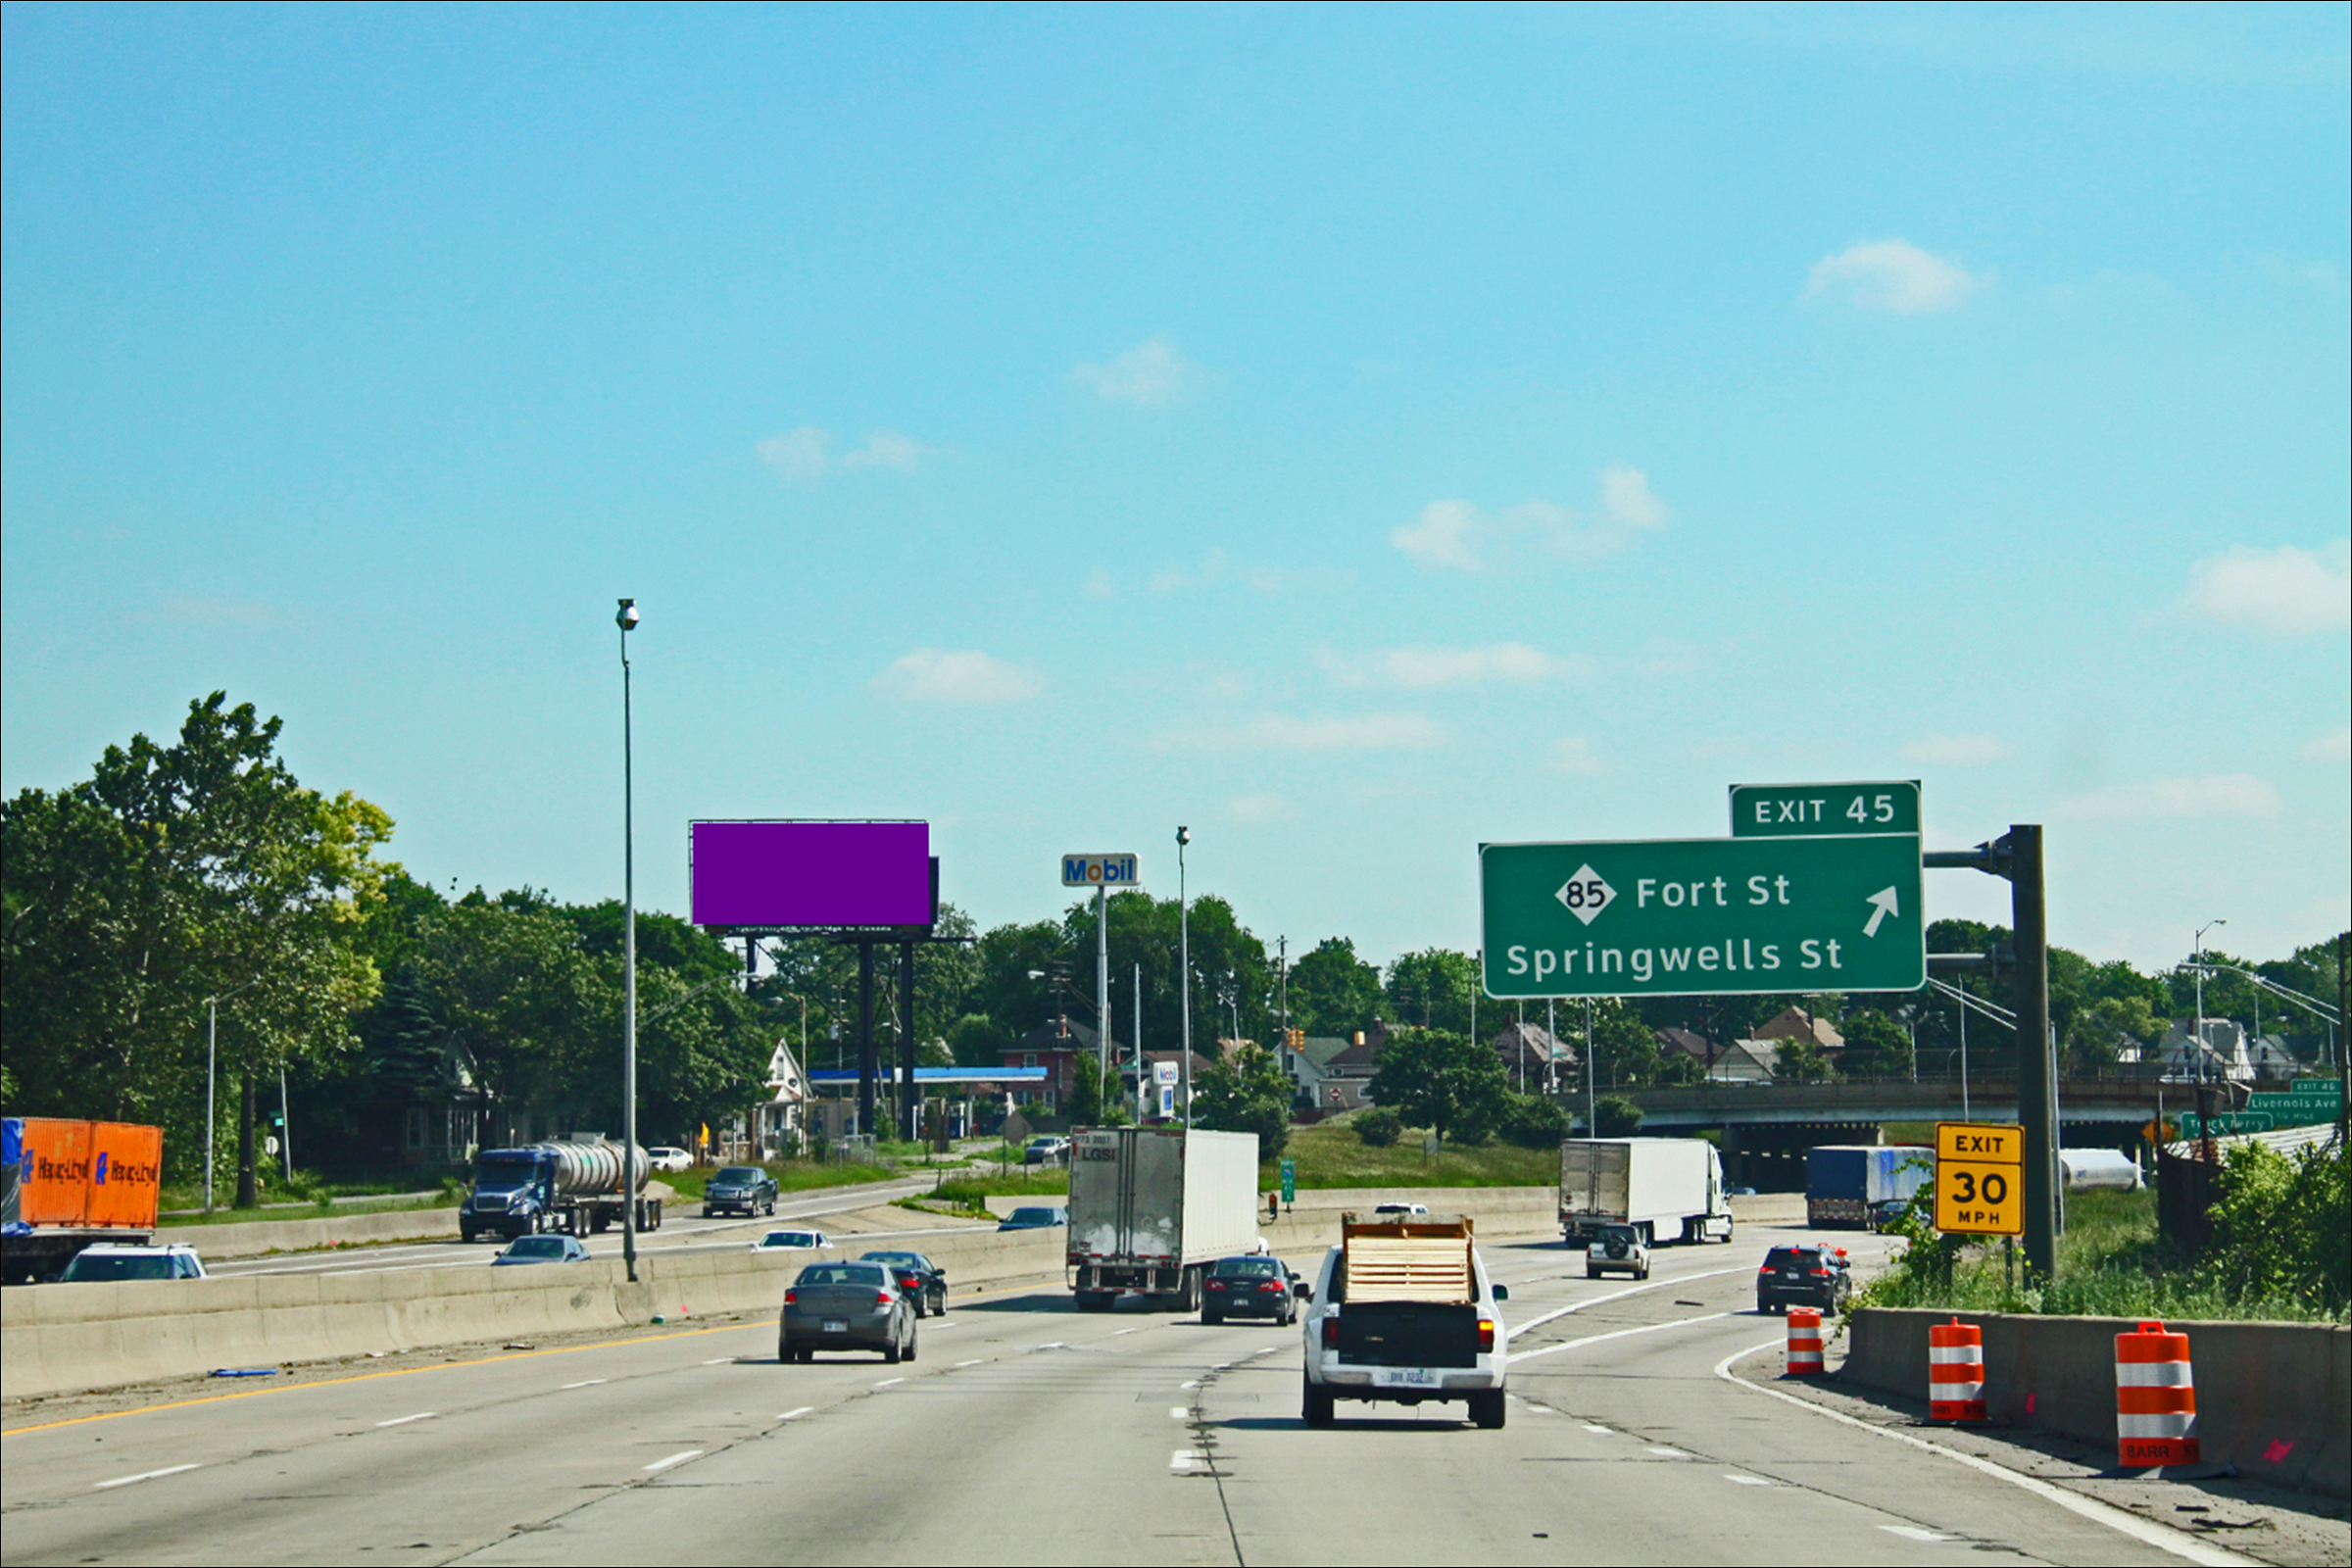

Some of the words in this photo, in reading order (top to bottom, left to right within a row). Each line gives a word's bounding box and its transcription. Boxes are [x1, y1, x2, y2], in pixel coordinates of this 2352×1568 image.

[1755, 800, 1826, 823] EXIT
[1845, 795, 1894, 823] 45
[1065, 858, 1133, 881] Mobil
[1566, 880, 1606, 908] 85
[1637, 876, 1728, 908] Fort
[1747, 875, 1790, 906] St
[1506, 939, 1782, 983] Springwells
[1799, 938, 1842, 969] St
[2296, 1082, 2317, 1091] EXIT
[2251, 1098, 2311, 1108] Livernois
[2315, 1099, 2337, 1108] Ave
[2293, 1111, 2315, 1120] MILE
[1955, 1135, 2004, 1152] EXIT
[1082, 1148, 1115, 1161] LGSI
[1951, 1171, 2008, 1205] 30
[1958, 1210, 2000, 1225] MPH
[2127, 1445, 2170, 1458] BARR
